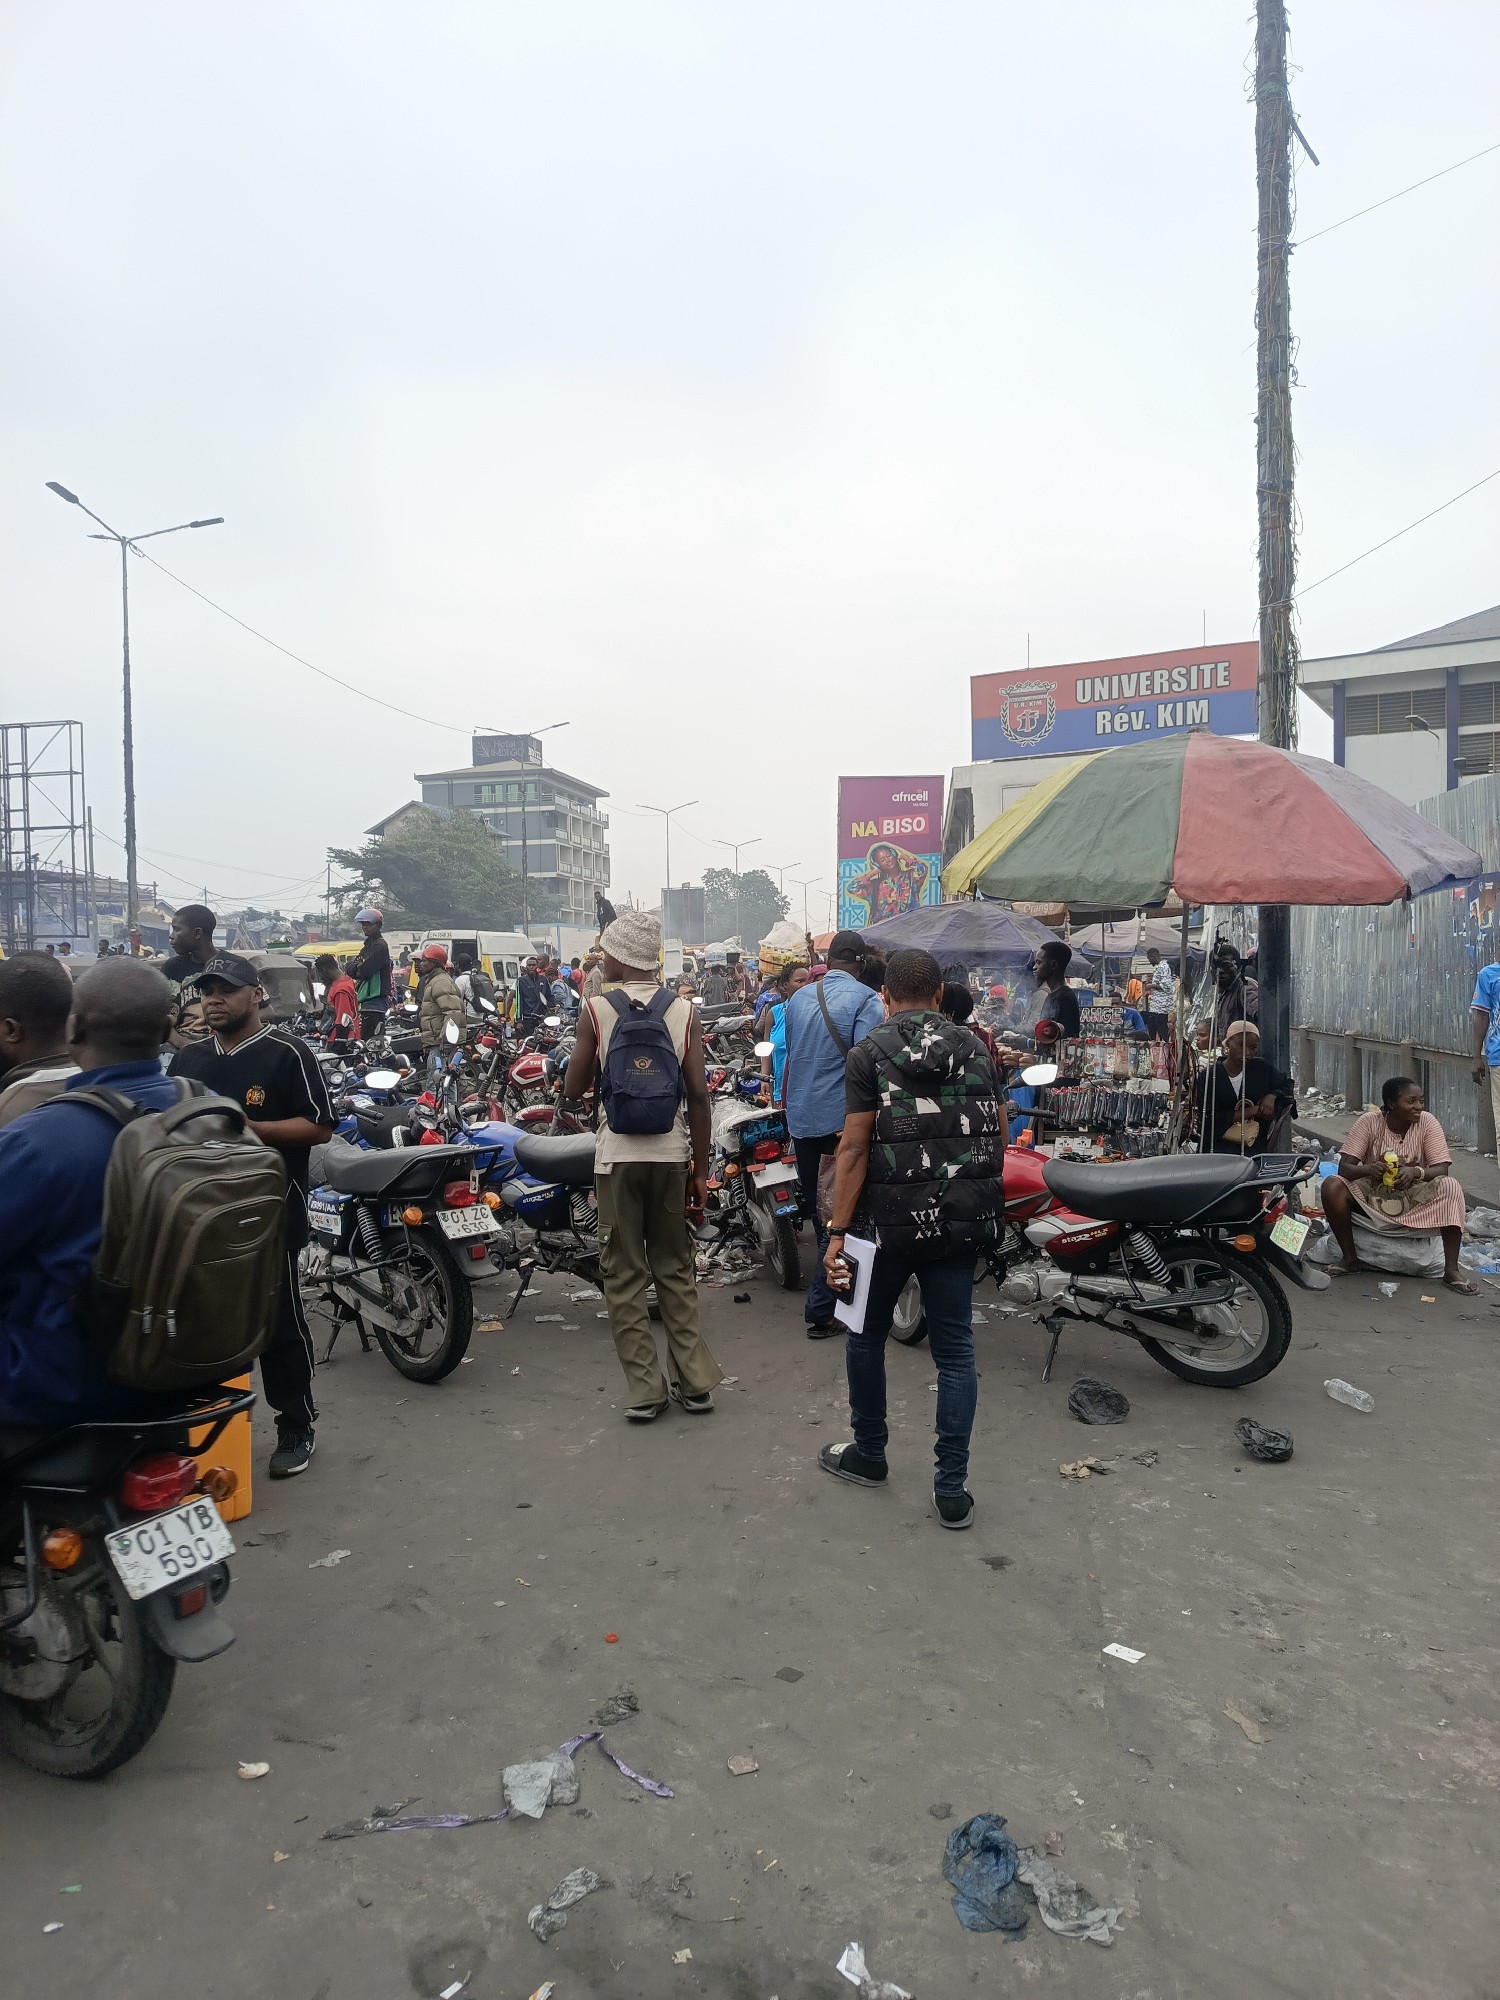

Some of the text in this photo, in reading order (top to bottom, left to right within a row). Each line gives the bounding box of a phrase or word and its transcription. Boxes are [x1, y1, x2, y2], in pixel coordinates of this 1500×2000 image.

[1076, 661, 1231, 704] UNIVERSITE
[1096, 699, 1210, 735] Rév. KIM
[891, 790, 929, 802] africell
[852, 817, 926, 838] NA BISO
[1023, 903, 1054, 913] Orange
[450, 1209, 468, 1223] 01
[136, 1504, 213, 1555] 01 YB
[158, 1537, 213, 1577] 590
